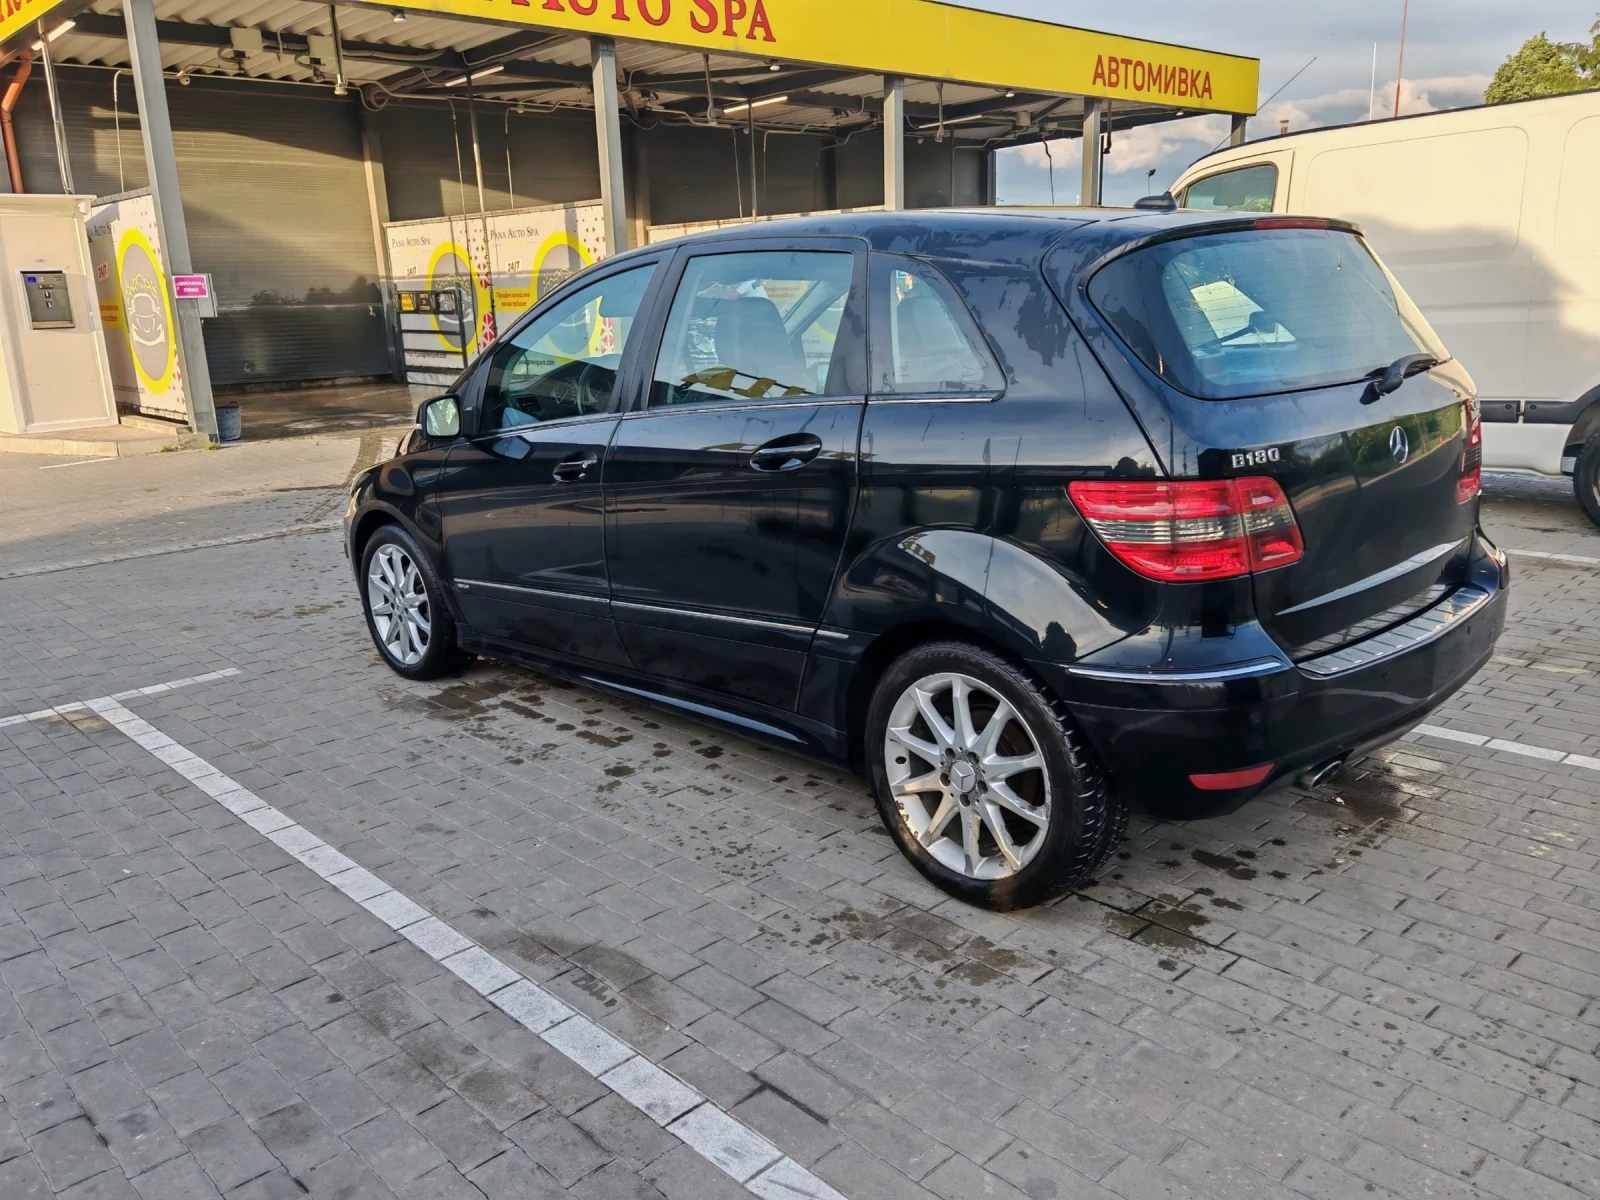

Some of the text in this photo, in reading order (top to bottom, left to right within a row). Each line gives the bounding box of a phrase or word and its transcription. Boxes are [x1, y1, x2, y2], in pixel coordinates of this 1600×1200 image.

[511, 0, 777, 42] TO SPA
[1092, 54, 1213, 100] АВТОМИВКА
[490, 226, 539, 240] PANA AUTO SPA
[391, 236, 431, 248] PANA AUTO SPA
[508, 260, 520, 272] 24/7
[1231, 447, 1280, 468] B180
